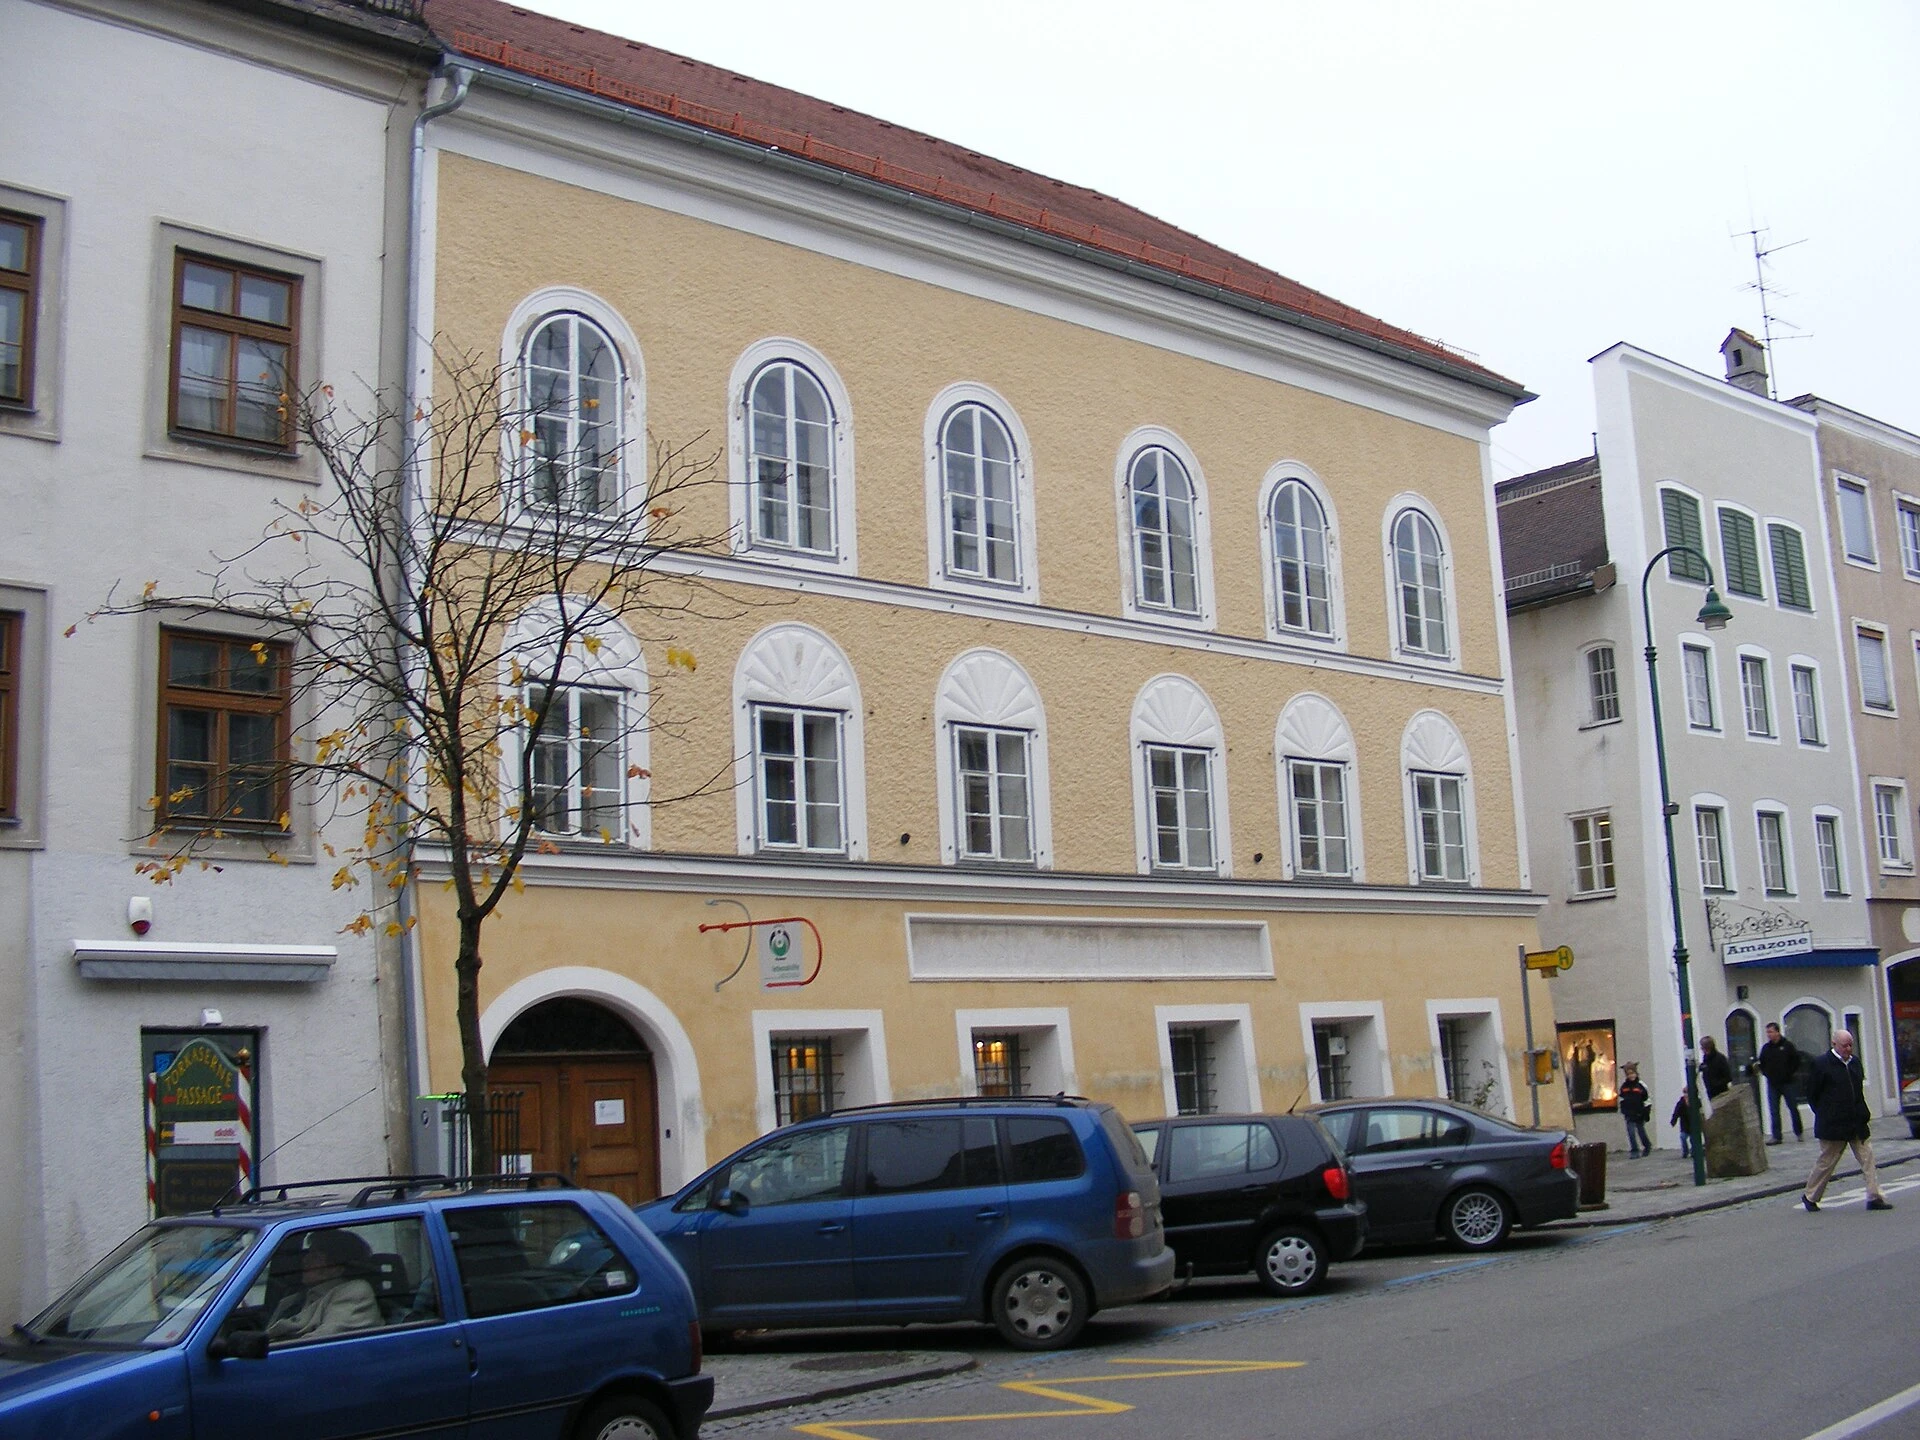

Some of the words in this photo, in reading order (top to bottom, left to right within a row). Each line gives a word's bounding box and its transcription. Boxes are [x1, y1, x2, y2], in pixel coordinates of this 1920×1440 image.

[1726, 937, 1809, 956] Amazone
[1558, 950, 1570, 966] H
[176, 1086, 223, 1105] PASSAGE
